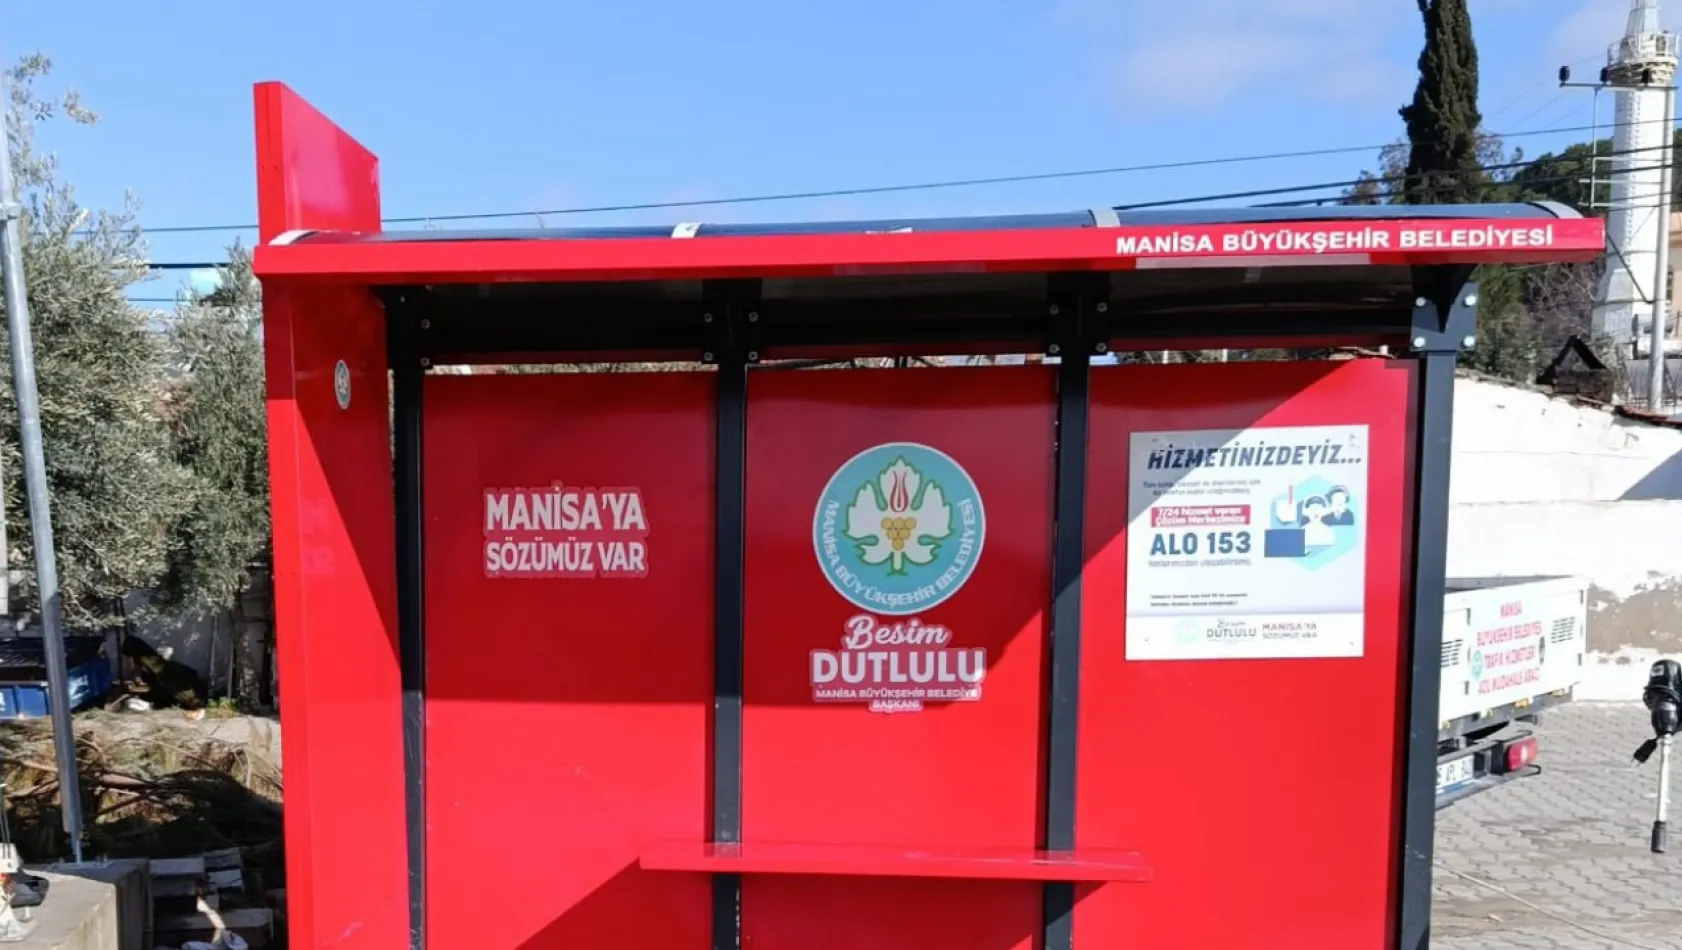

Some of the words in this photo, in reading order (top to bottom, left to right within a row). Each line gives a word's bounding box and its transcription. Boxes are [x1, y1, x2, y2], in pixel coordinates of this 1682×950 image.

[1116, 231, 1214, 255] MANİSA
[1223, 227, 1389, 255] BÜYÜKŞEHİR
[1399, 224, 1553, 249] BELEDİYESİ
[486, 486, 647, 531] MANİSA'YA
[822, 500, 841, 567] MANİSA
[1150, 532, 1199, 555] ALO
[1207, 531, 1252, 554] 153
[486, 536, 595, 571] SÖZÜMÜZ
[598, 541, 646, 571] VAR
[844, 616, 948, 650] Besim
[1206, 627, 1257, 639] DUTLULU
[813, 650, 984, 683] DUTLULU
[816, 687, 857, 698] MANİSA
[859, 687, 926, 700] BÜYÜKŞEHİR
